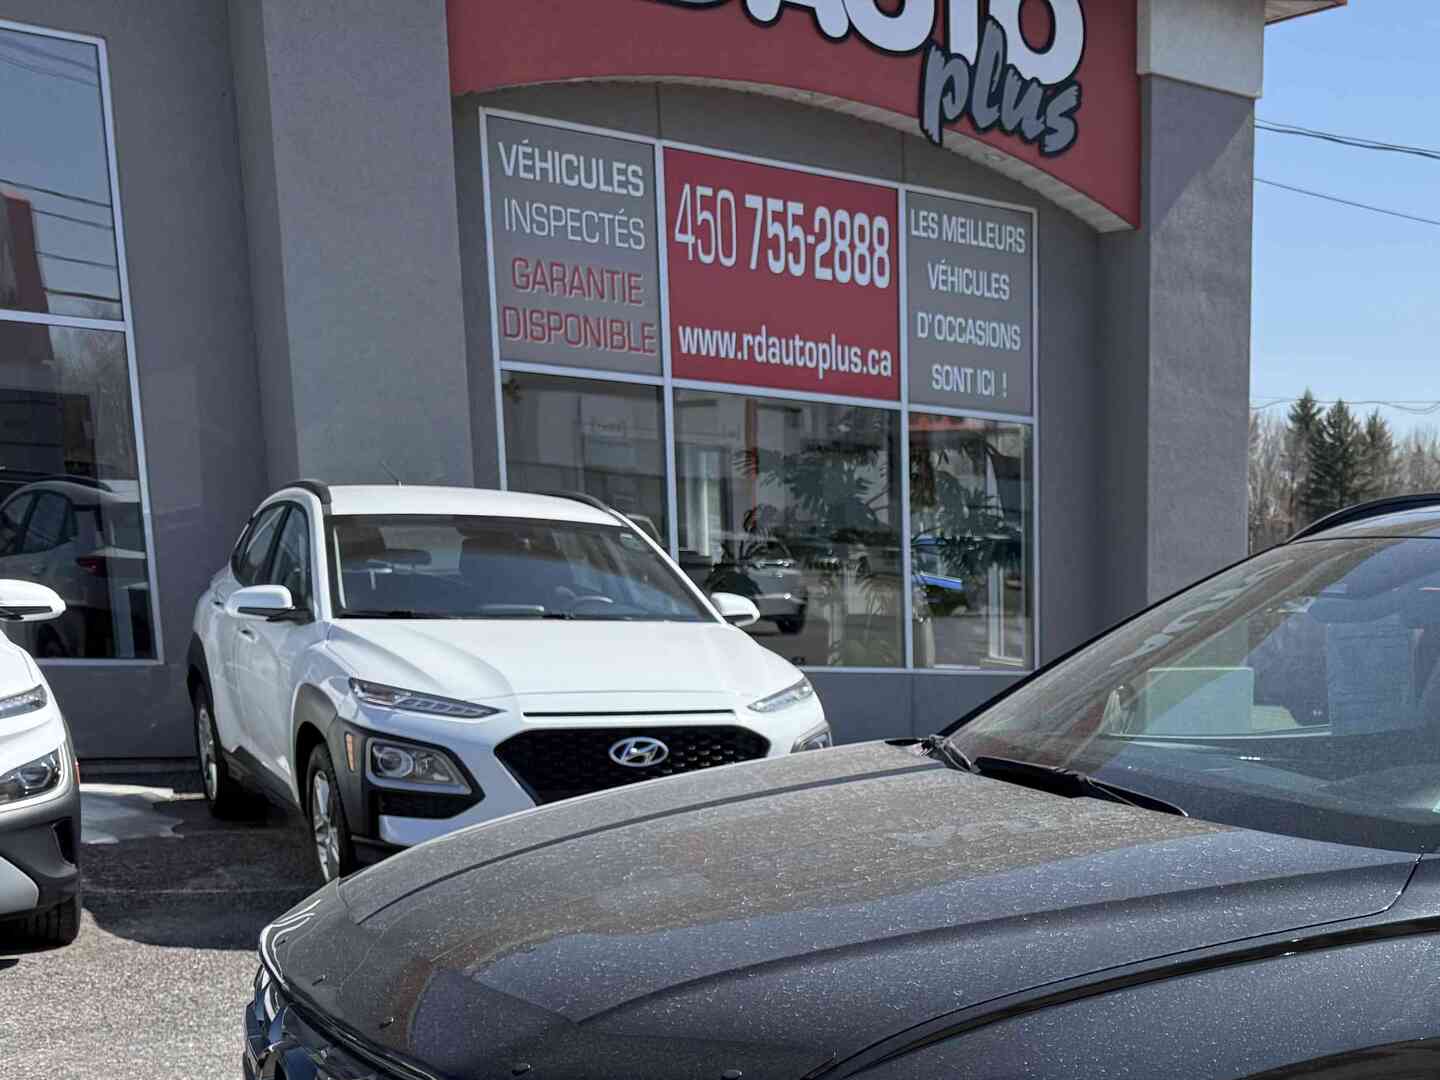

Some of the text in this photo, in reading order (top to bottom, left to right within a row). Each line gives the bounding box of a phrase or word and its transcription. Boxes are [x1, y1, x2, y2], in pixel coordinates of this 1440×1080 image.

[921, 15, 1081, 154] plus
[498, 139, 645, 197] VÉHICULES
[503, 197, 645, 250] INSPECTÉS
[674, 183, 891, 290] 450 755-2888
[910, 208, 1026, 254] LES MEILLEURS
[511, 257, 643, 306] GARANTIE
[927, 259, 1011, 301] VÉHICULES
[502, 303, 657, 356] DISPONIBLE
[677, 324, 893, 380] www.rdautoplus.ca
[931, 363, 974, 394] SONT
[976, 369, 996, 397] ICI
